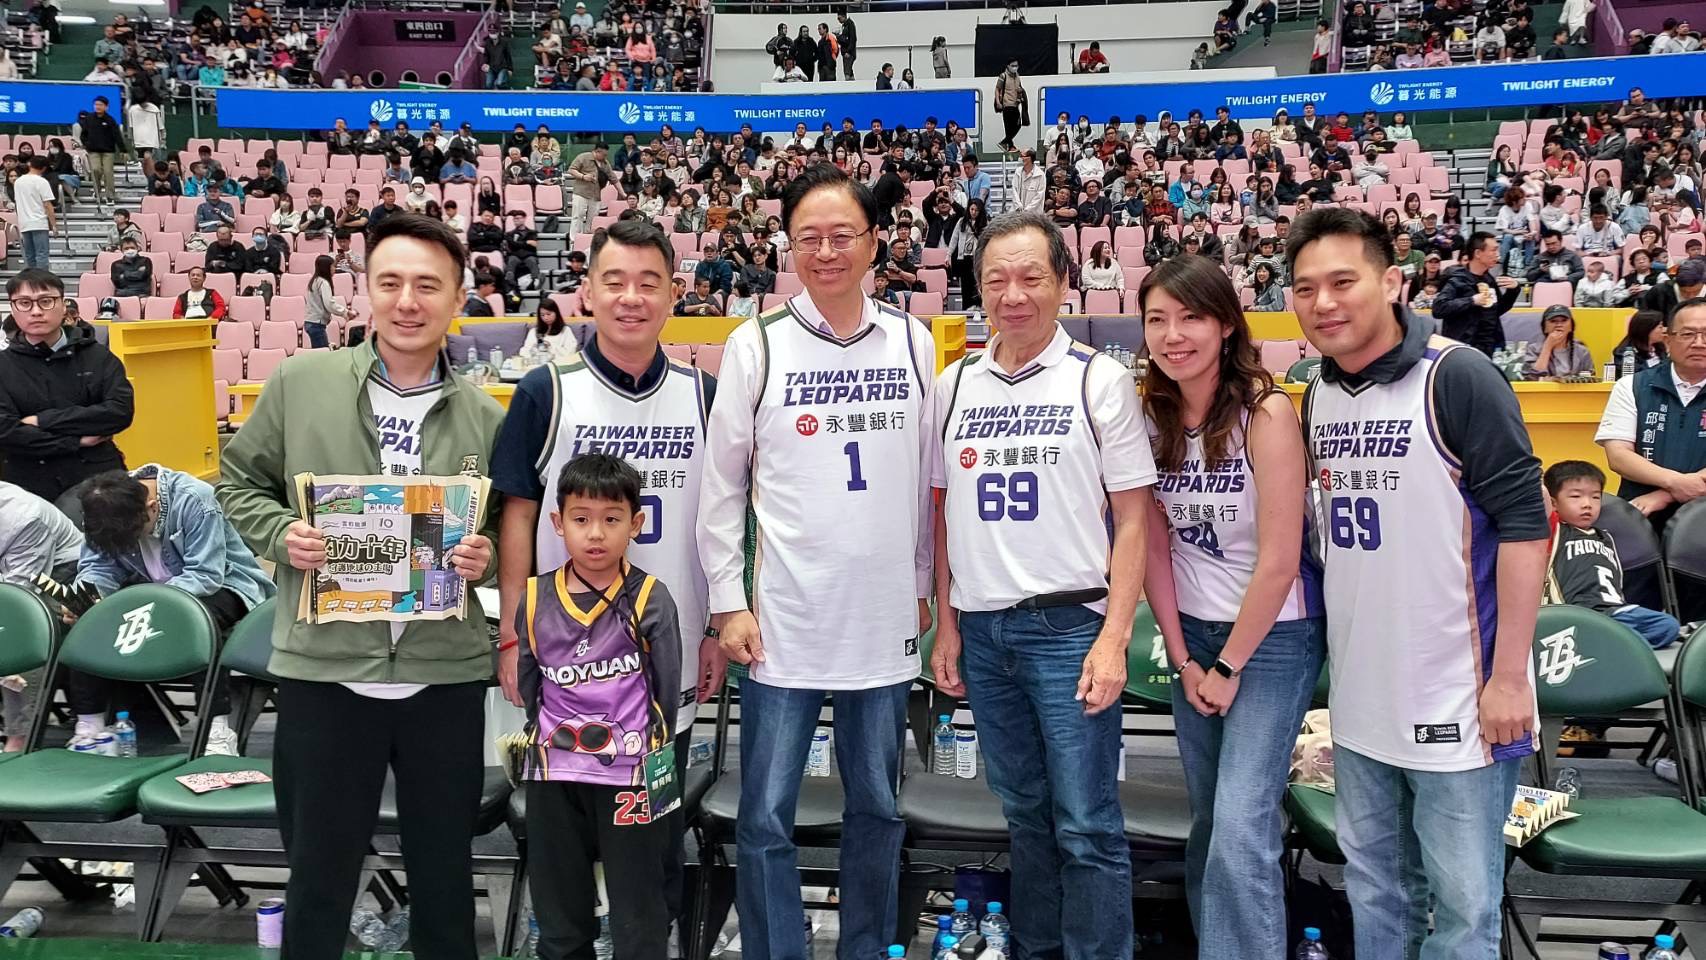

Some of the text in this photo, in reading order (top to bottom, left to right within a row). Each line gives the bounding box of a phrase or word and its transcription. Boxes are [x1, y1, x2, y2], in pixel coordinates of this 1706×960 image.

[1502, 76, 1616, 92] TWILIGHT ENERGY
[1225, 92, 1328, 106] TWILIGHT ENERGY
[482, 107, 580, 117] TWILIGHT ENERGY
[734, 108, 827, 119] TWILIGHT ENERGY
[785, 368, 907, 386] TAIWAN BEER
[783, 382, 910, 407] LEOPARDS
[826, 411, 905, 433] 永豐銀行
[961, 404, 1075, 422] TAIWAN BEER
[374, 415, 414, 433] WAN
[575, 425, 695, 440] TAIWAN BEER
[954, 418, 1073, 441] LEOPARDS
[1313, 419, 1413, 439] TAIWAN BEER
[572, 440, 694, 459] LEOPARDS
[983, 446, 1061, 467] 永豐銀行
[1313, 437, 1411, 460] LEOPARDS
[844, 441, 867, 491] 1
[639, 470, 687, 489] 豐銀行
[1153, 474, 1246, 494] EOPARDS
[1332, 470, 1400, 491] 永豐銀行
[976, 471, 1039, 522] 69
[633, 495, 662, 545] 0
[1330, 496, 1382, 551] 69
[1594, 565, 1624, 605] 5
